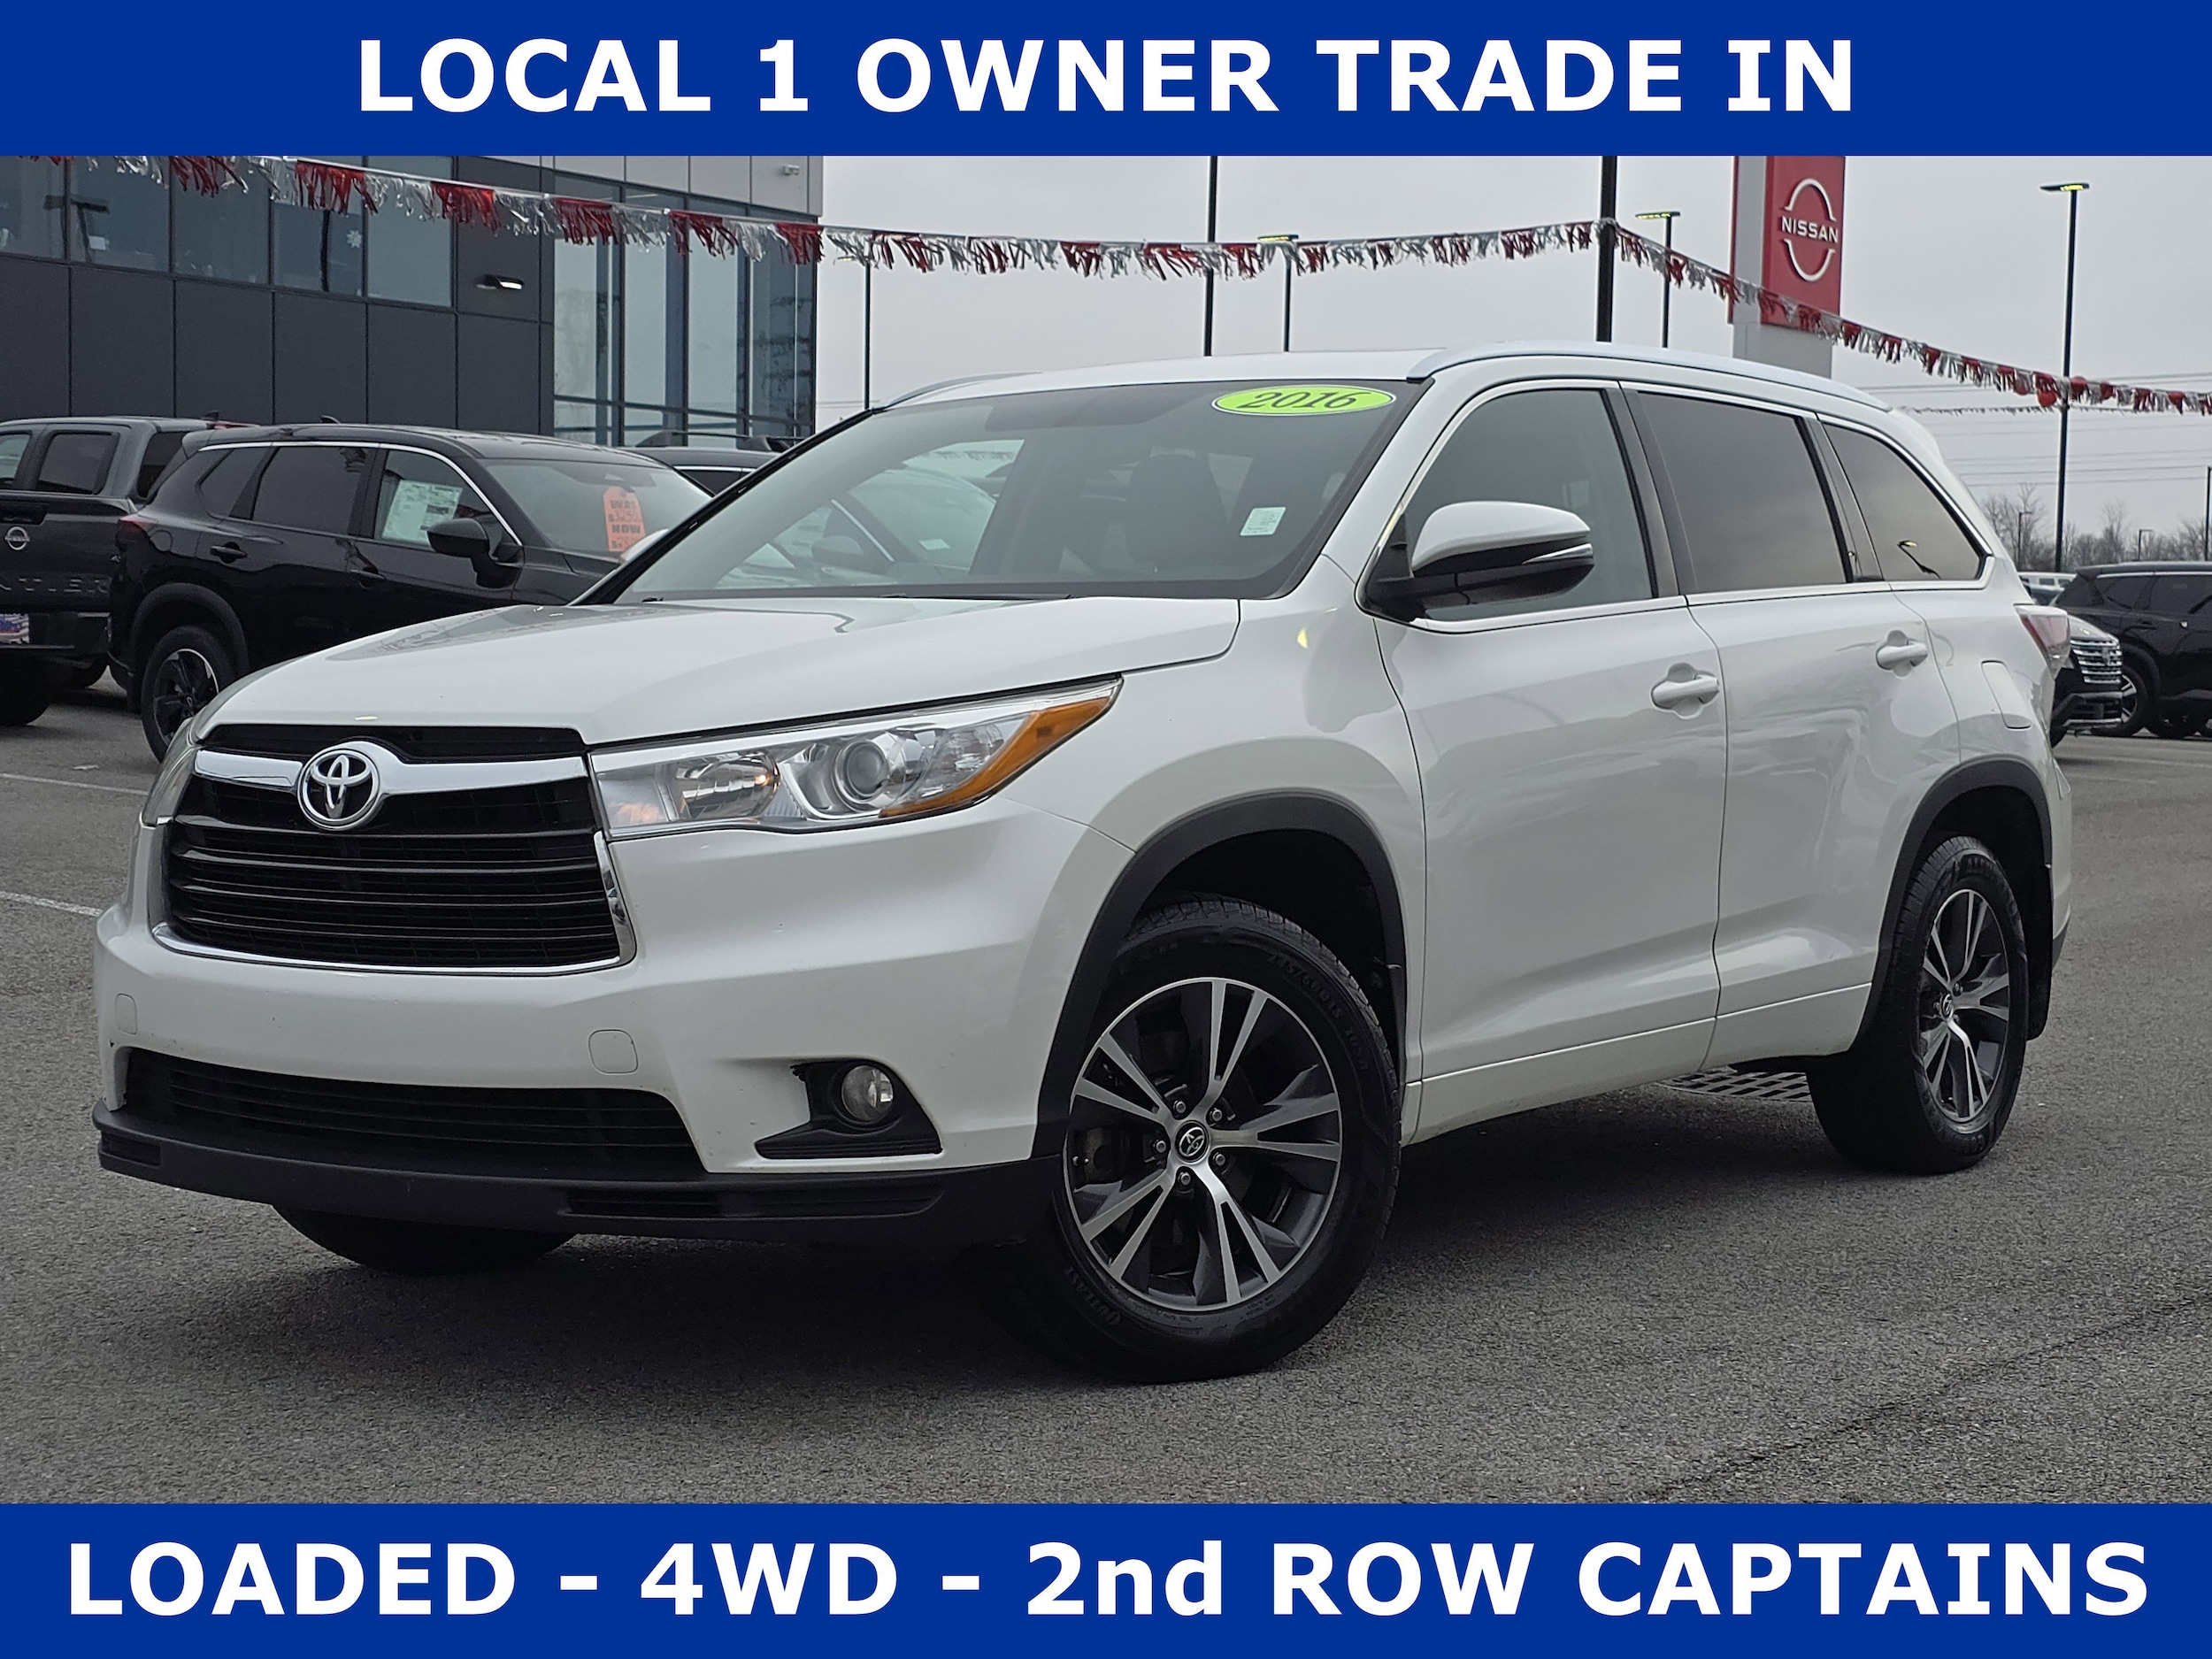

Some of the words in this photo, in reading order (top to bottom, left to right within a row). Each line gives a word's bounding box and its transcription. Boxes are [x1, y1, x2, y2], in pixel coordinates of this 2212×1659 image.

[1781, 216, 1839, 243] NISSAN
[1236, 391, 1371, 410] 2016
[611, 525, 641, 534] NOW
